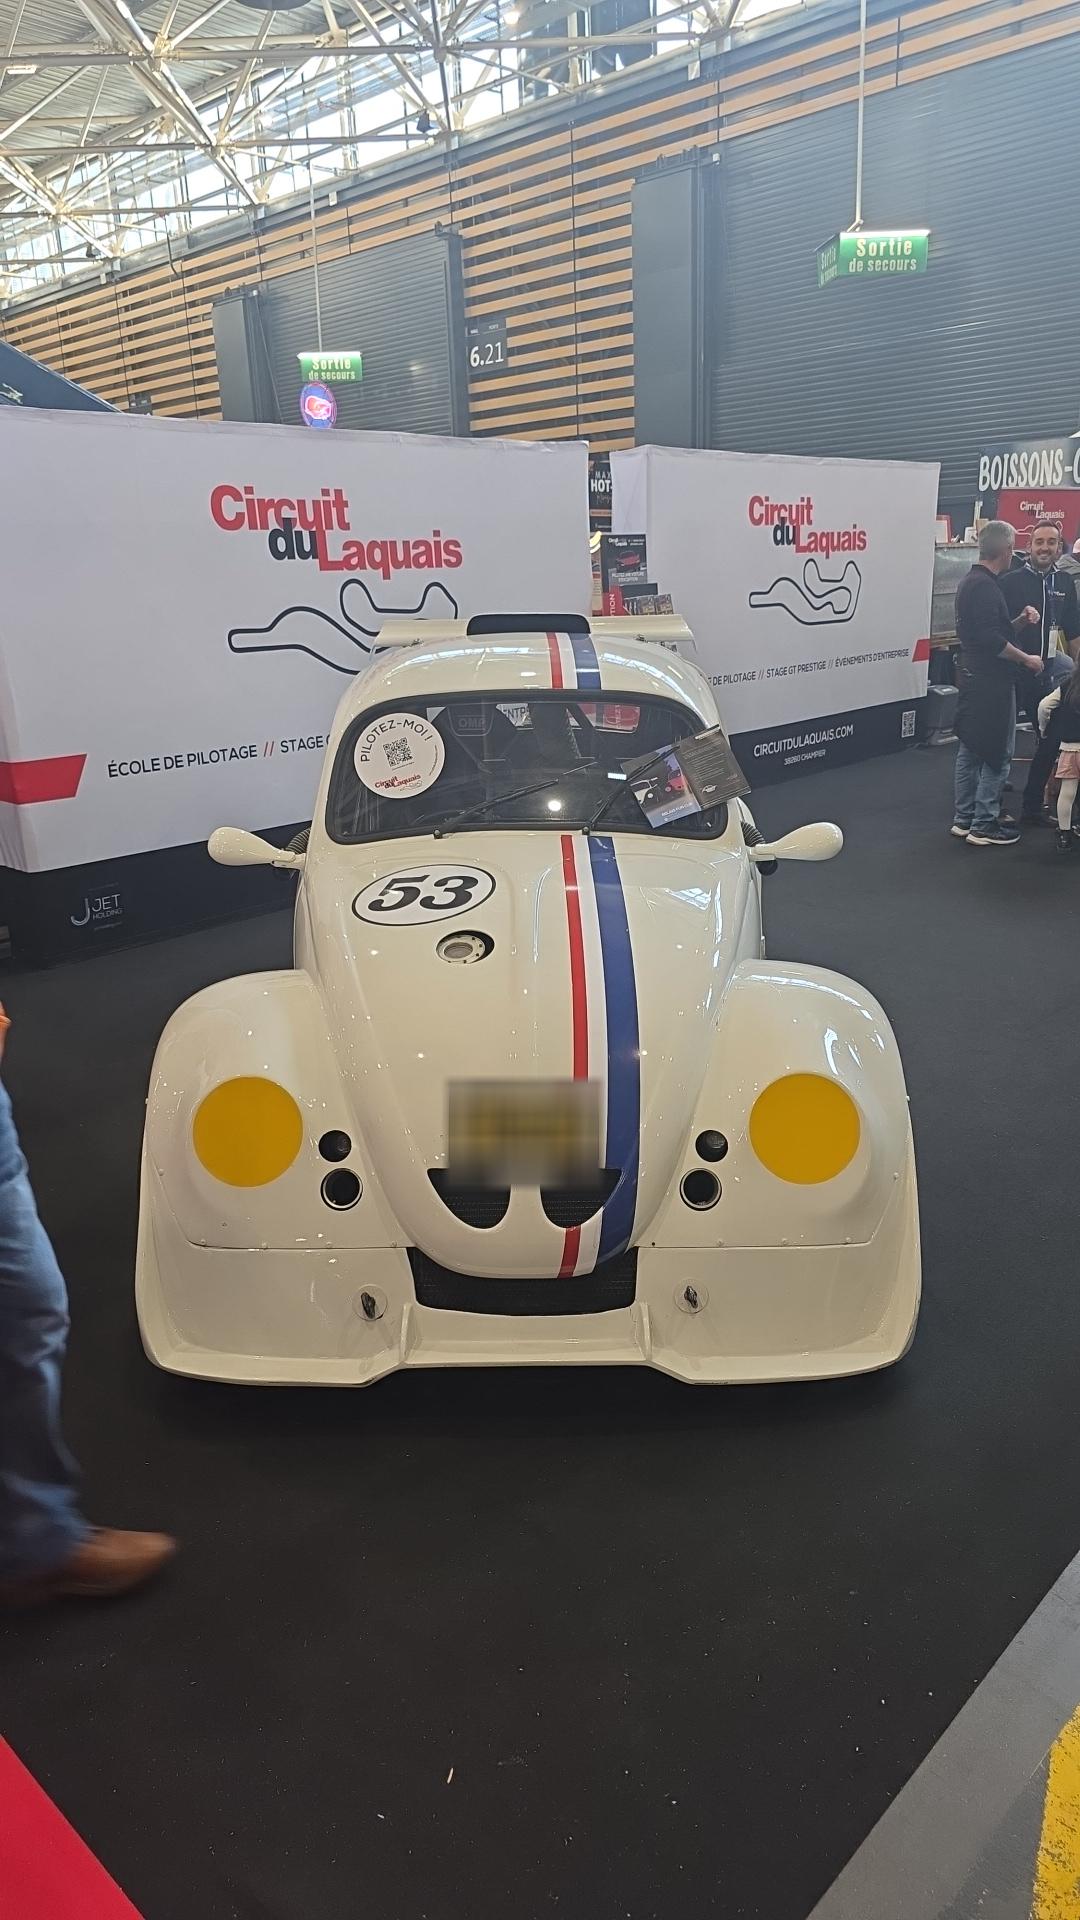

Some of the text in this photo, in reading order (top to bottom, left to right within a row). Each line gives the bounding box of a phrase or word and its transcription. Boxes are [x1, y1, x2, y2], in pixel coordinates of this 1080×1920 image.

[856, 237, 912, 257] Sortie
[849, 258, 917, 272] de secours
[312, 357, 351, 370] Sortie
[470, 342, 504, 368] 6.21
[308, 370, 356, 380] de secours
[210, 484, 351, 531] Circuit
[748, 495, 813, 526] Circuit
[1036, 509, 1065, 520] Laquais
[268, 517, 463, 580] du Laquais
[773, 517, 867, 559] du Laquais
[713, 675, 723, 686] DE
[723, 671, 756, 684] PILOTAGE
[767, 666, 788, 678] STAGE
[788, 665, 797, 675] GT
[798, 660, 827, 674] PRESTIGE
[753, 724, 854, 757] CIRCUITDULAQUAIS.COM
[107, 757, 161, 778] ÉCOLE
[164, 754, 184, 770] DE
[187, 745, 258, 767] PILOTAGE
[280, 735, 324, 753] STAGE
[375, 775, 399, 788] Circuit
[393, 774, 421, 788] Laquais
[92, 893, 120, 912] JET
[367, 874, 479, 912] 53
